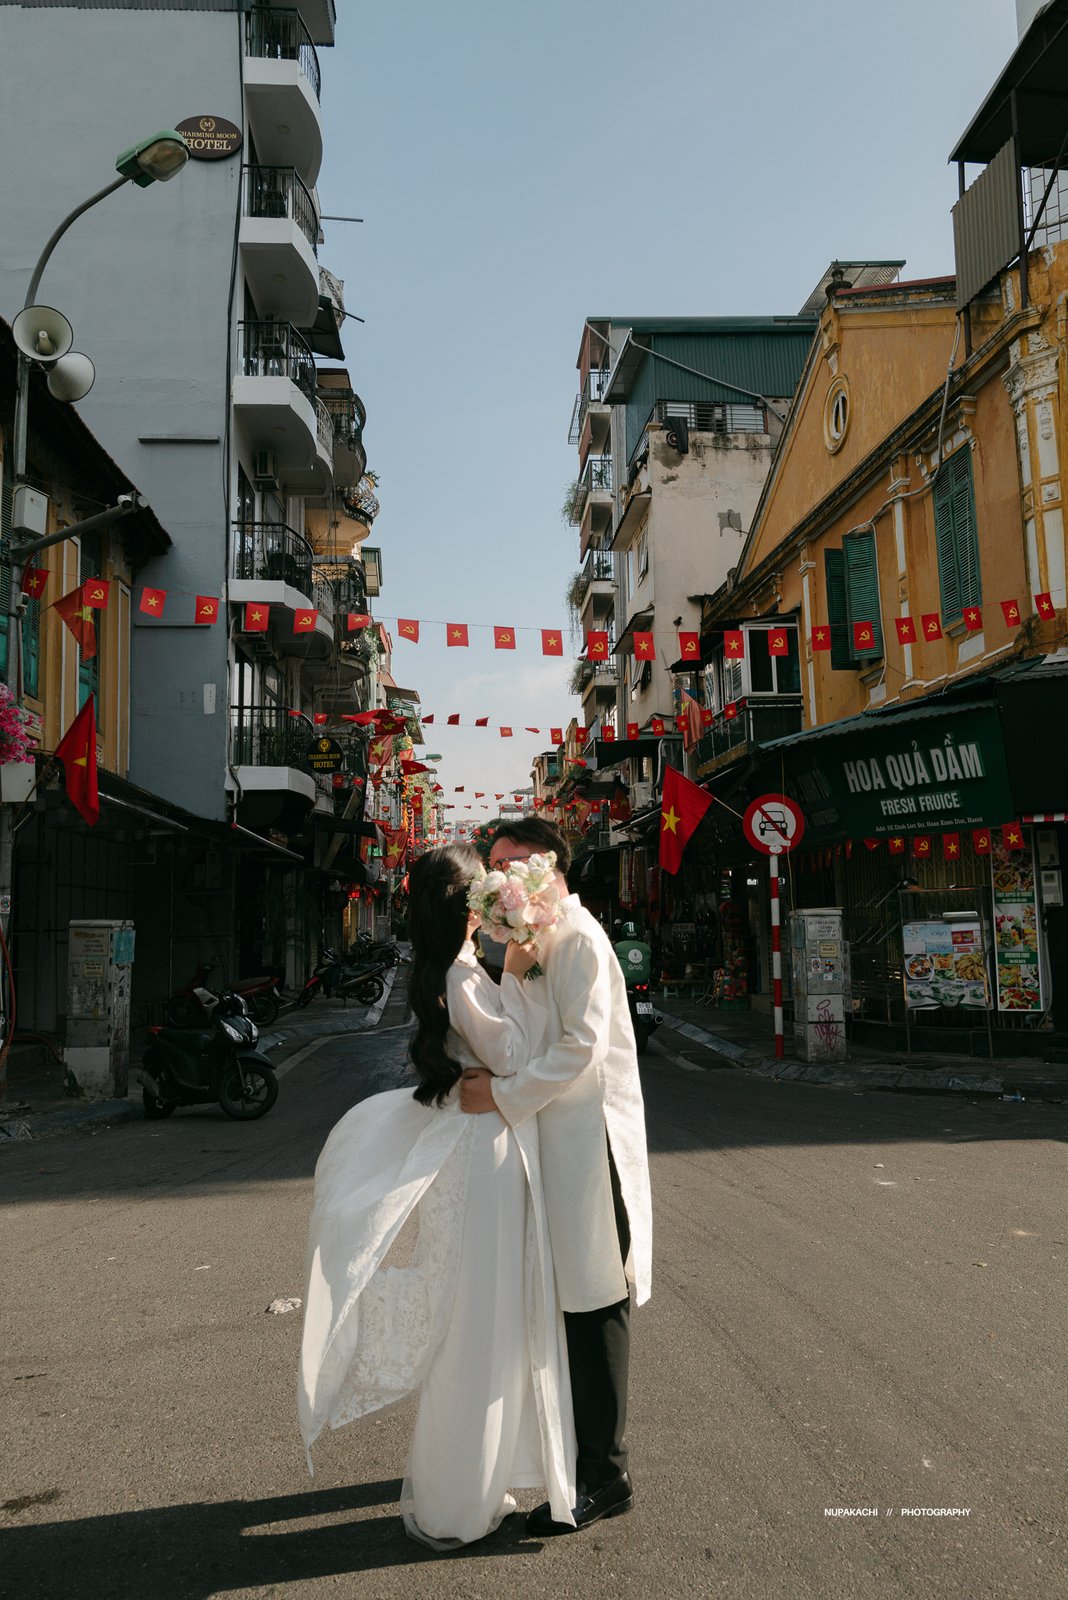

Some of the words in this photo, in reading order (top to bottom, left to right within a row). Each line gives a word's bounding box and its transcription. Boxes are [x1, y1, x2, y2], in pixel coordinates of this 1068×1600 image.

[185, 138, 231, 150] HOTEL
[313, 760, 335, 768] HOTEL
[842, 757, 886, 793] HOA
[885, 740, 932, 791] QUẢ
[929, 733, 984, 782] DẦM
[880, 798, 917, 816] FRESH
[919, 792, 960, 812] FRUICE
